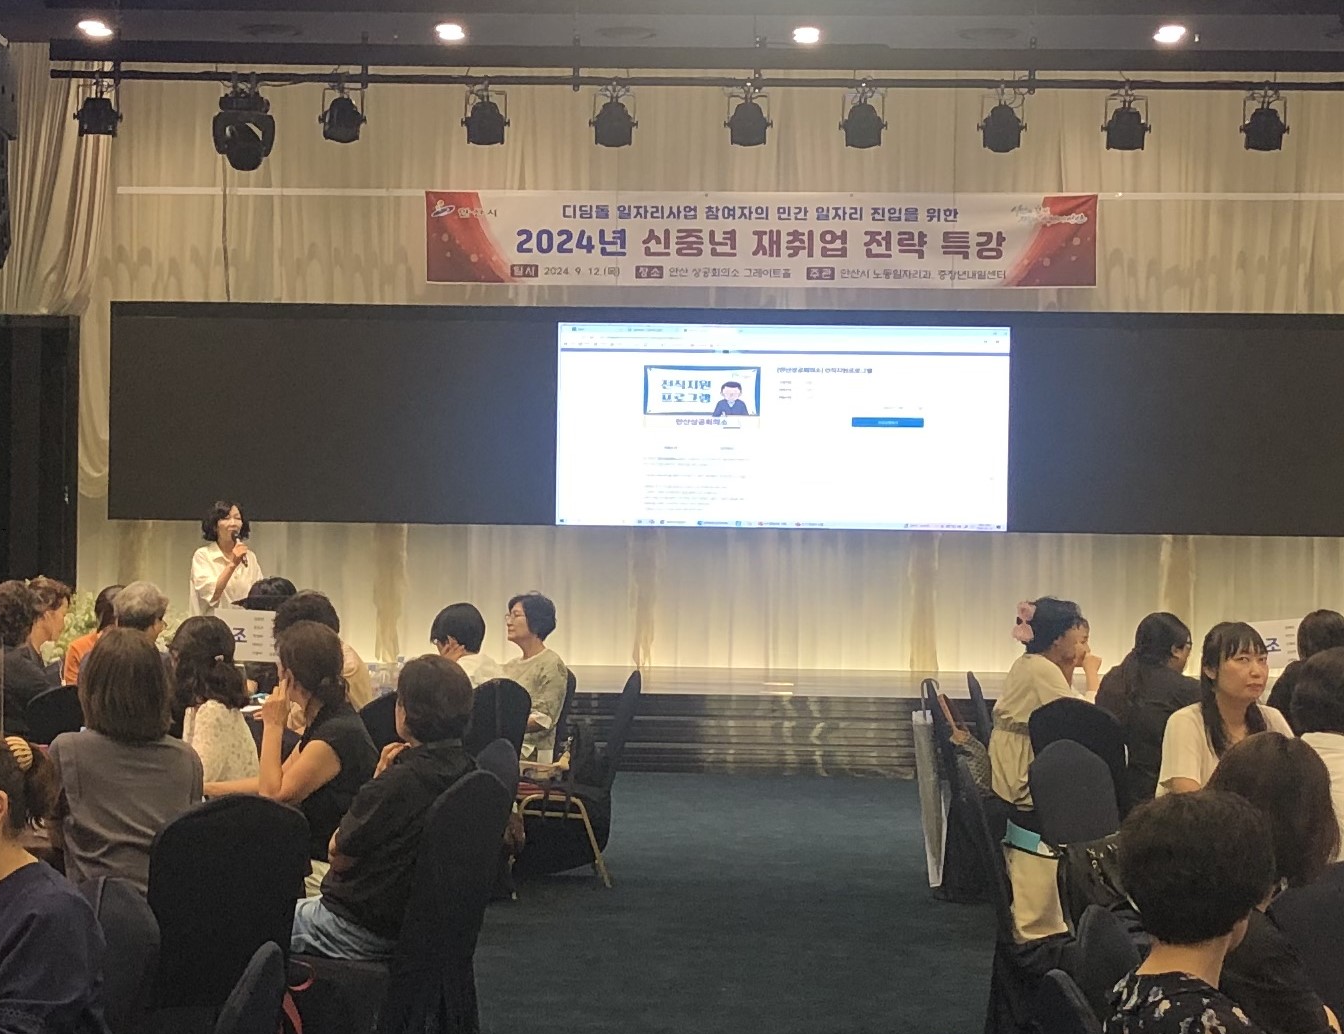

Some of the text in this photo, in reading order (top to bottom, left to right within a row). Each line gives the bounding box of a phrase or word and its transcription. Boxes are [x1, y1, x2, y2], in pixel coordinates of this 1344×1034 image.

[562, 204, 959, 223] 디딤돌 일자리사업 참여자의 민간 일자리 진입을 위한
[516, 228, 1007, 261] 2024년 신중년 재취업 전략 특강
[513, 265, 536, 276] 일시
[638, 266, 660, 277] 장소
[668, 267, 689, 278] 안산
[743, 268, 791, 279] 그레이트홀
[809, 268, 832, 279] 주관
[840, 268, 870, 279] 안산시
[937, 270, 1006, 281] 중장년내일센터
[232, 627, 248, 643] 조
[1265, 637, 1282, 653] 조
